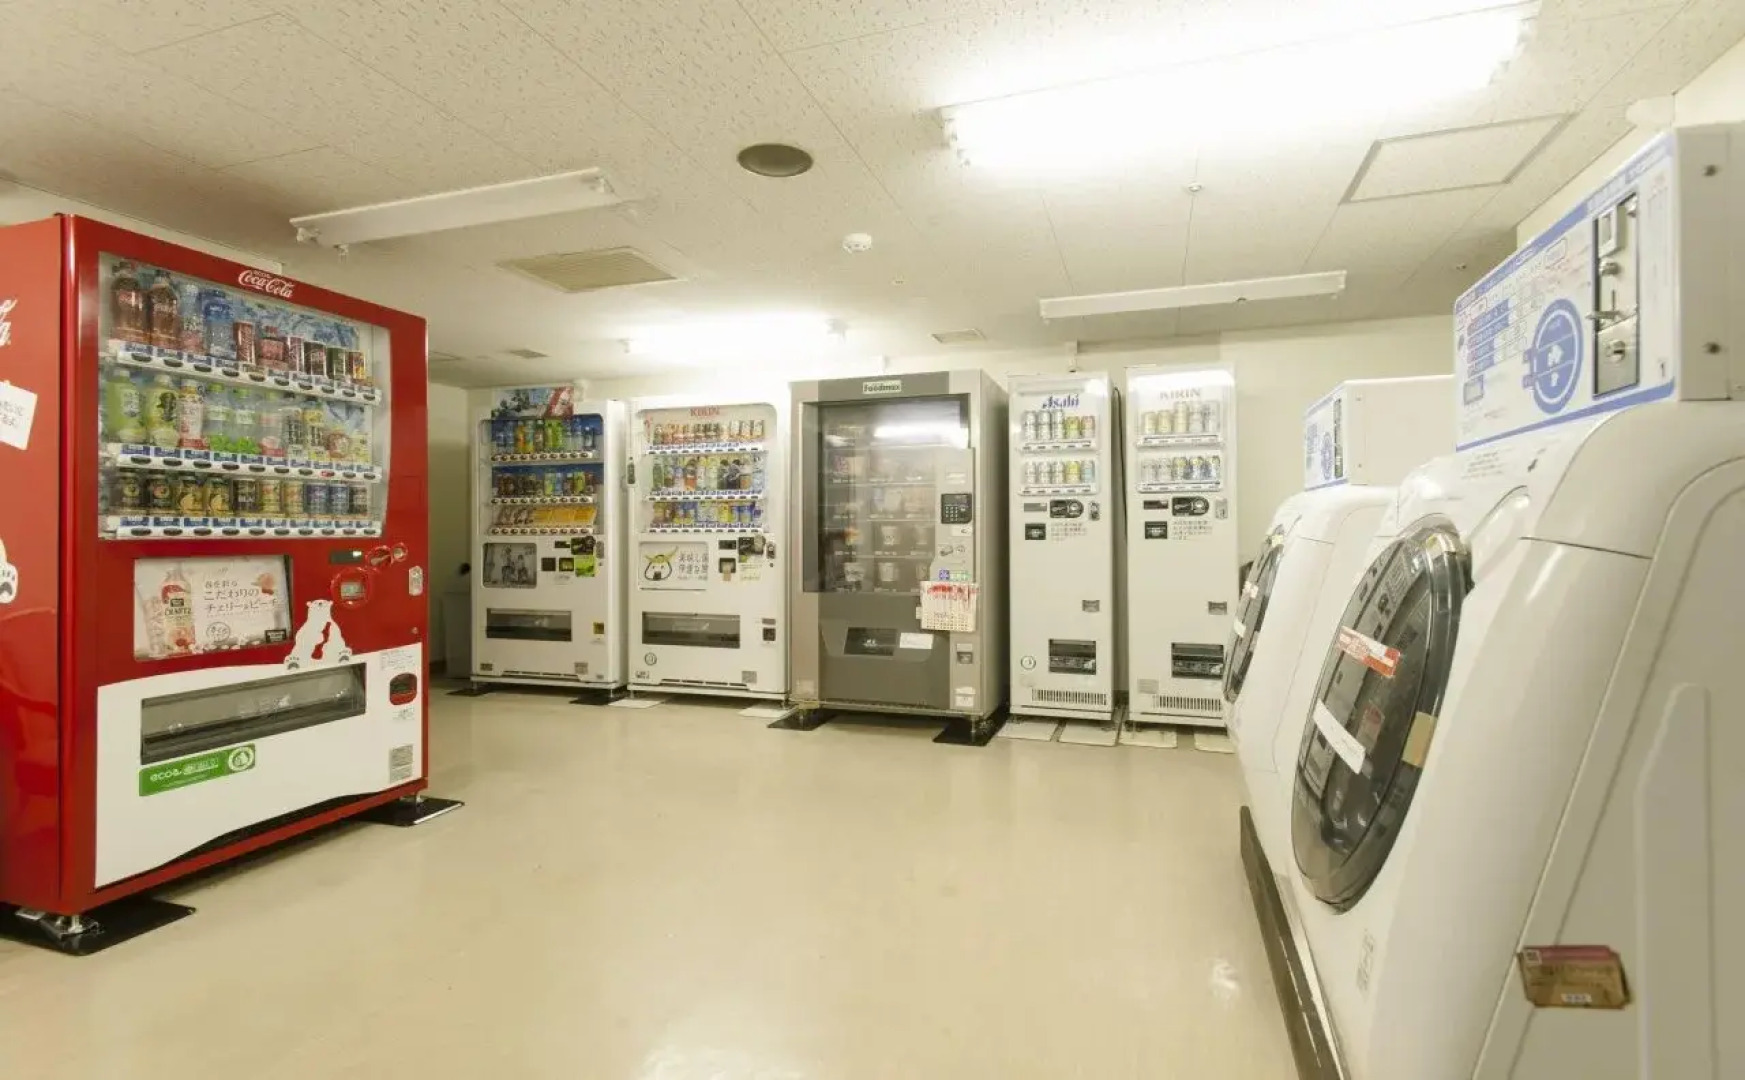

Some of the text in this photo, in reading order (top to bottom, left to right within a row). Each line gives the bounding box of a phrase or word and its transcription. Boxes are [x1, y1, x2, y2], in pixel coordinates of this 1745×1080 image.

[238, 269, 294, 298] Coca-Cola
[1159, 387, 1201, 400] KIRIN
[1042, 393, 1079, 410] Asahi
[690, 407, 720, 417] KIRIN
[204, 588, 259, 600] こだわりの
